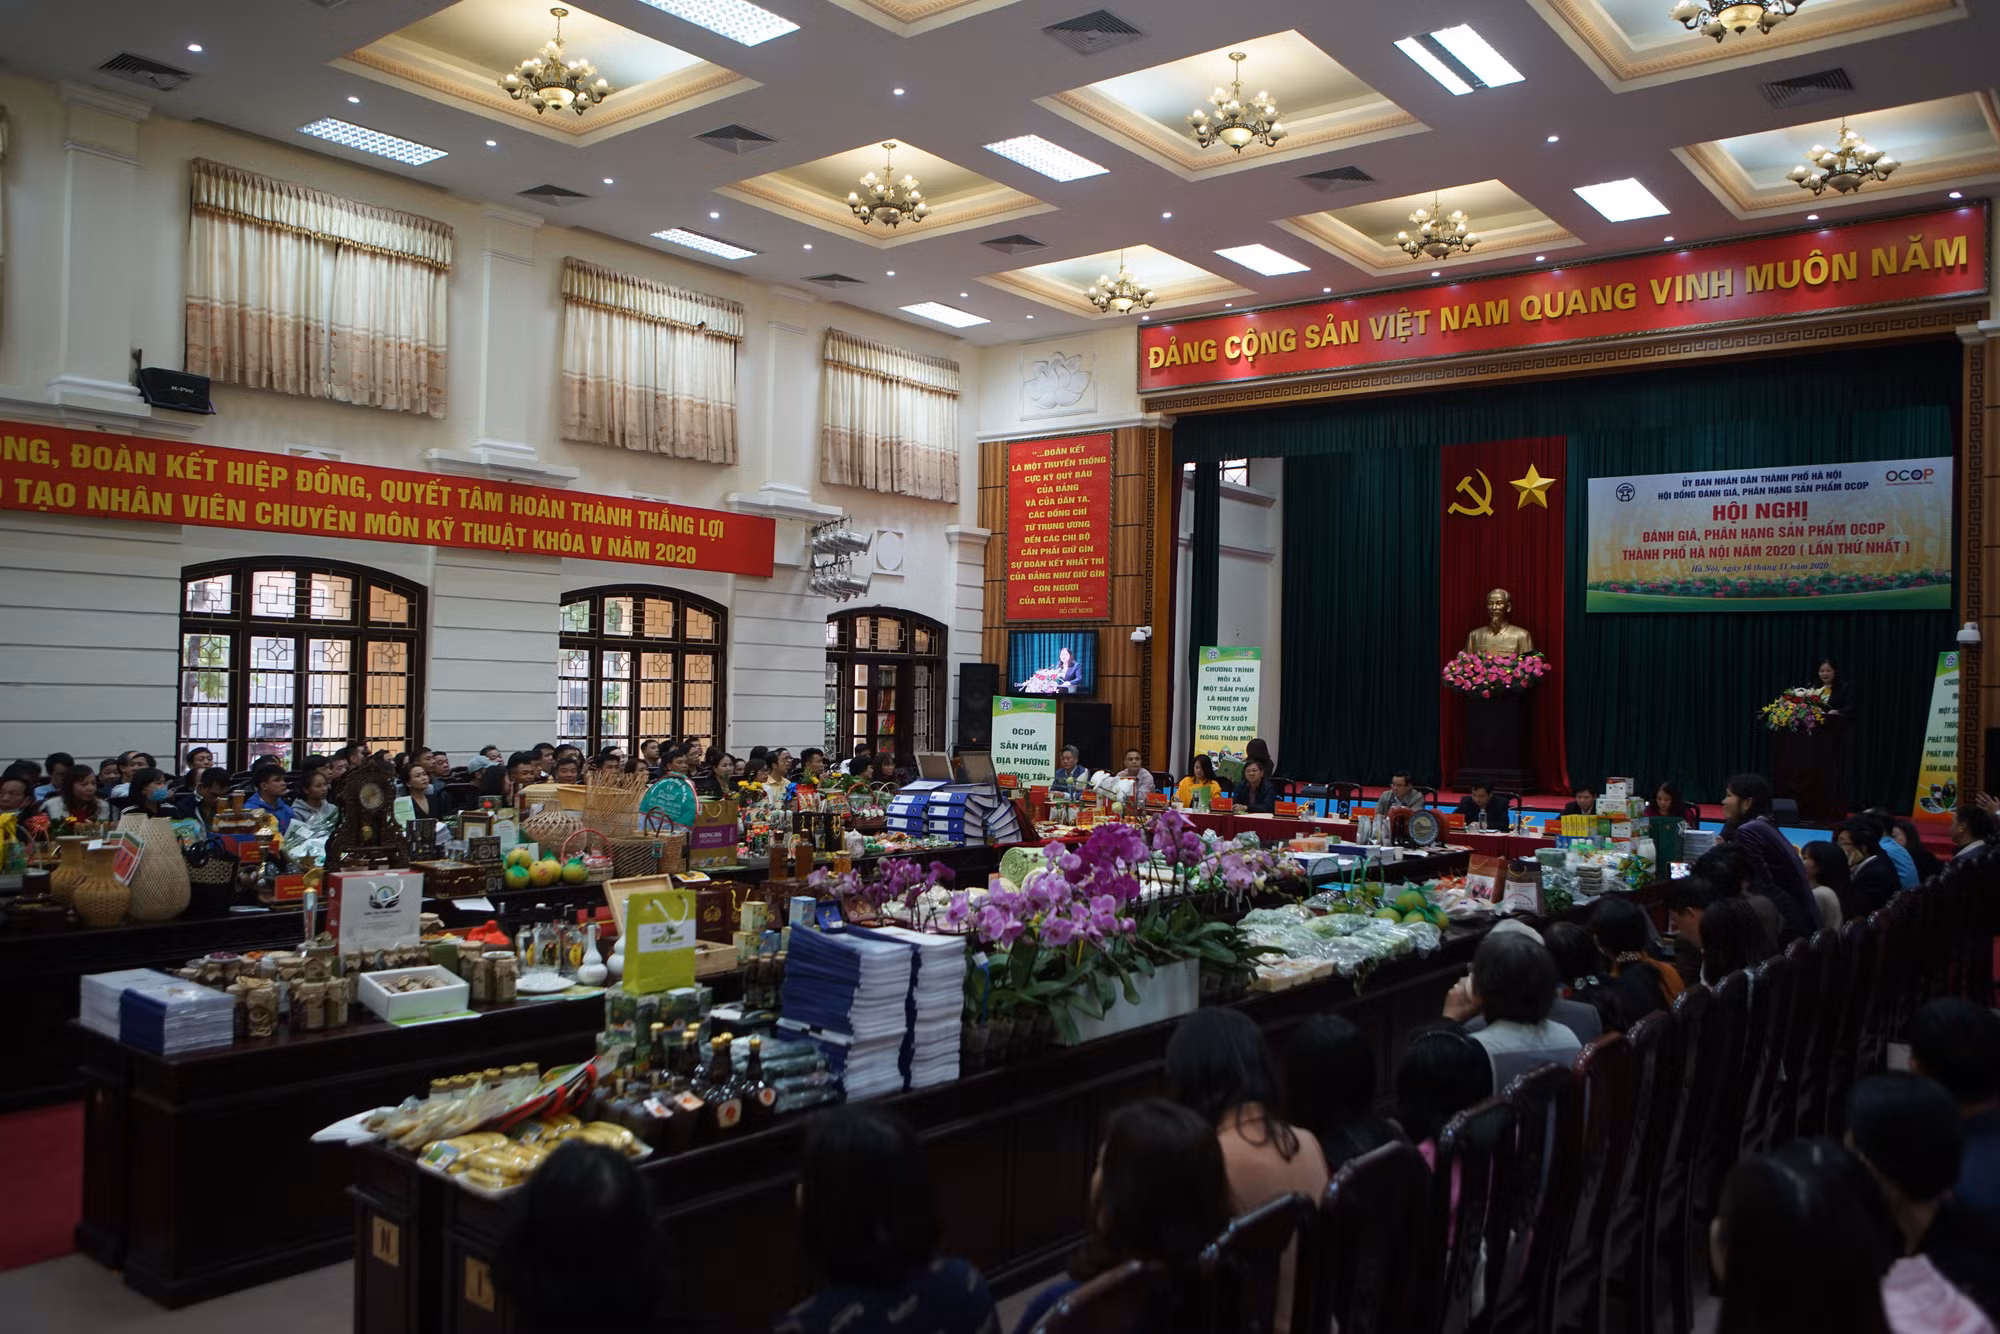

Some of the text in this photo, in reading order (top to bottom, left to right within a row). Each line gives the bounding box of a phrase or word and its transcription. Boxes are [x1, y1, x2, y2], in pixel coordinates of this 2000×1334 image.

[1149, 234, 1967, 369] ĐẢNG CỘNG SẢN VIỆT NAM QUANG VINH MUÔN NĂM
[1070, 444, 1086, 454] KẾT
[1012, 455, 1106, 472] LÀ MỘT TRUYỀN THỐNG
[1025, 470, 1092, 484] CỰC KỲ QUÝ BÁU
[1682, 470, 1842, 487] ỦY BAN NHÂN DÂN THÀNH PHỐ HÀ NỘI
[1886, 469, 1934, 482] OCOP
[0, 435, 725, 540] NG, ĐOÀN KẾT HIỆP ĐỒNG, QUYẾT TÂM HOÀN THÀNH THẮNG LỢI
[1037, 482, 1079, 494] CỦA ĐẢNG
[1658, 491, 1672, 501] HỘI
[1674, 489, 1696, 499] ĐỒNG
[1698, 488, 1721, 498] ĐÁNH
[1742, 486, 1765, 496] PHÂN
[1768, 485, 1791, 496] HẠNG
[1794, 482, 1813, 493] SẢN
[1816, 481, 1841, 492] PHẨM
[1844, 481, 1869, 491] OCOP
[1026, 498, 1036, 507] VÀ
[1038, 496, 1055, 506] CỦA
[1057, 496, 1075, 504] DÂN
[1028, 507, 1087, 519] CÁC ĐỒNG CHÍ
[1713, 501, 1808, 524] HỘI NGHỊ
[14, 478, 696, 565] TẠO NHÂN VIÊN CHUYÊN MÔN KỸ THUẬT KHÓA V NĂM 2020
[1025, 520, 1090, 531] TỪ TRUNG ƯƠNG
[1643, 520, 1885, 542] ĐÁNH GIÁ, PHÂN HẠNG SẢN PHẨM OCOP
[1024, 532, 1090, 544] ĐẾN CÁC CHI BỘ
[1021, 545, 1094, 556] CẦN PHẢI GIỮ GÌN
[1622, 537, 1901, 560] THÀNH PHỐ HÀ NỘI NĂM 2020 LẦN THỨ NHẤT
[1011, 556, 1104, 570] SỰ ĐOÀN KẾT NHẤT TRÍ
[1010, 570, 1105, 581] CỦA ĐẢNG NHƯ GIỮ GÌN
[1019, 595, 1035, 605] CỦA
[1012, 728, 1036, 736] OCOP
[1000, 740, 1047, 751] SẢN PHẨM
[996, 757, 1050, 766] ĐỊA PHƯƠNG
